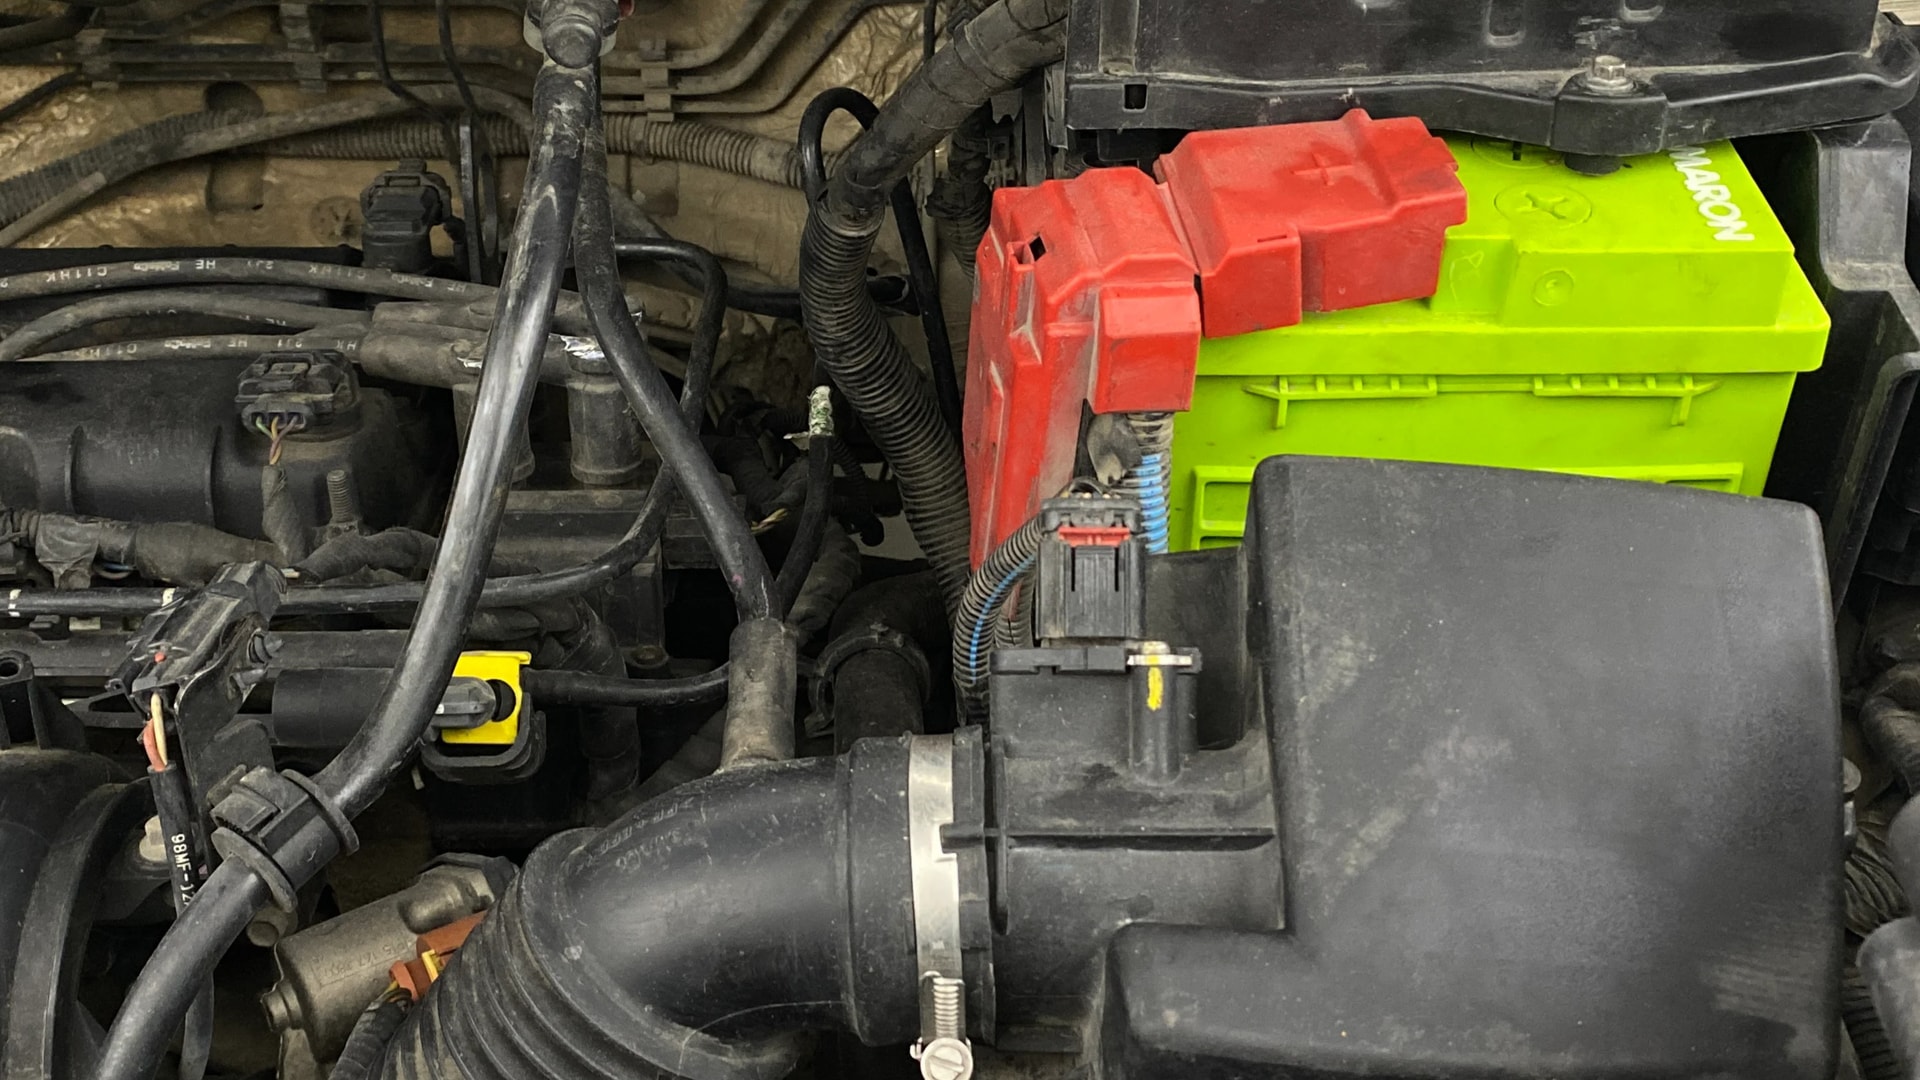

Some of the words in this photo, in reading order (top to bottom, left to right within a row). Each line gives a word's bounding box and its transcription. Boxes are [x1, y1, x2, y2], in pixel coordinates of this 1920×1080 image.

[1667, 145, 1756, 241] MARON
[194, 259, 216, 270] HE
[46, 266, 108, 283] C11HK
[335, 338, 358, 351] HK
